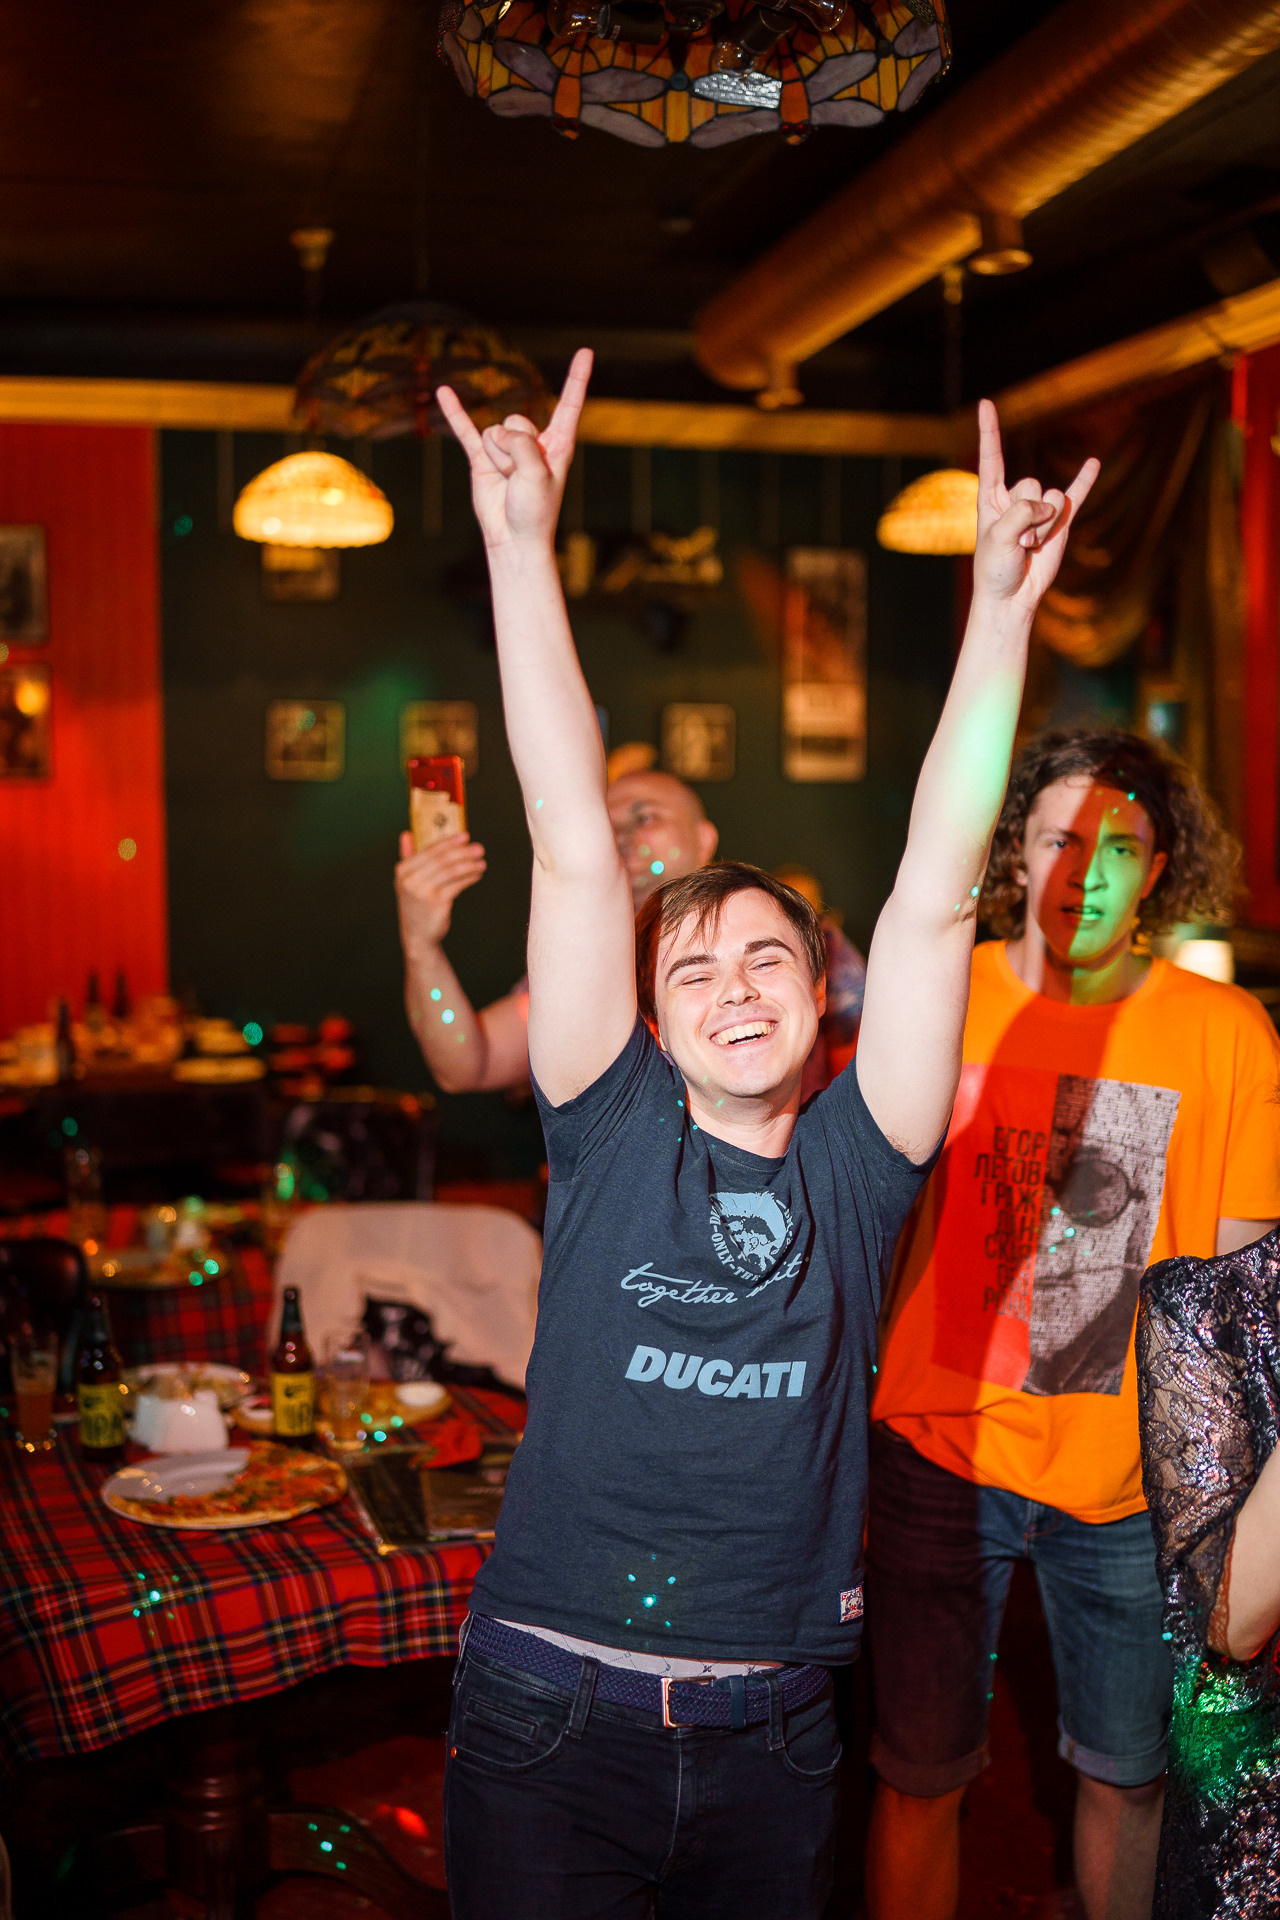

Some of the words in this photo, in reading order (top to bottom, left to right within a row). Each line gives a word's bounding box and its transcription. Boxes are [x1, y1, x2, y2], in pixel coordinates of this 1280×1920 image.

[993, 1126, 1046, 1158] ЕГОР
[974, 1153, 1042, 1186] ЛЕТОВ
[620, 1262, 738, 1308] together
[745, 1253, 803, 1299] wit
[625, 1344, 807, 1399] DUCATI
